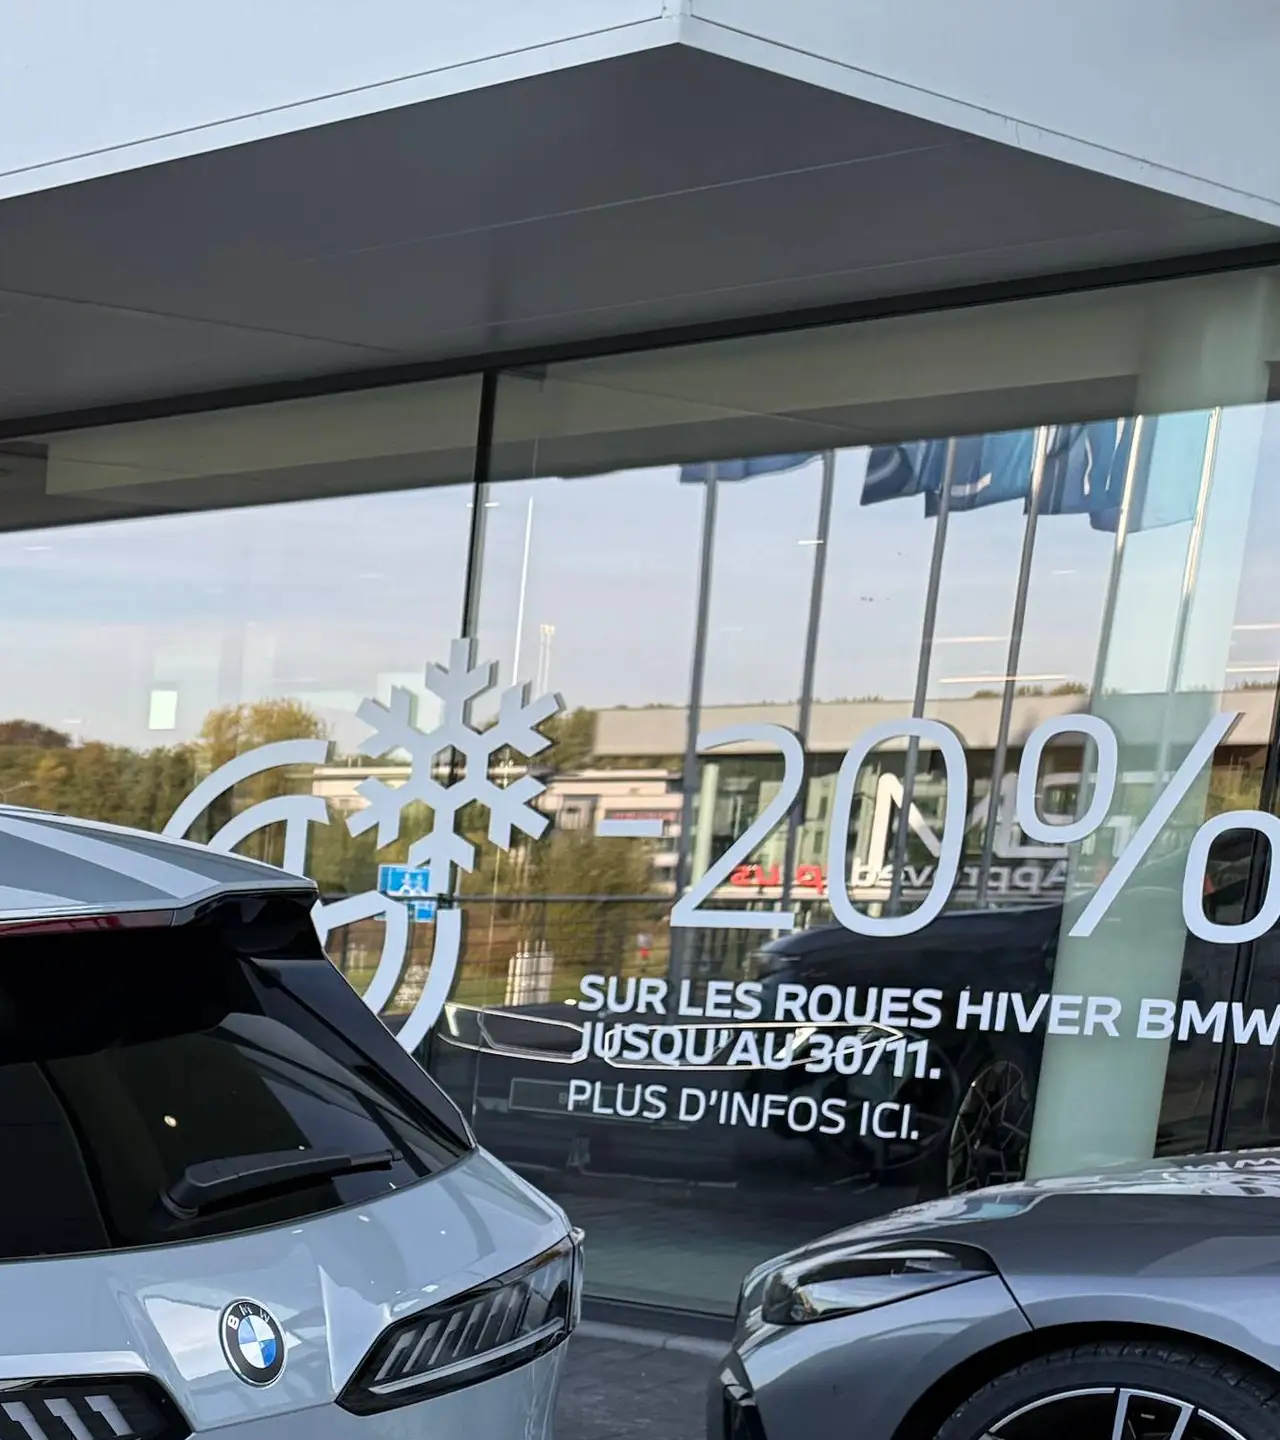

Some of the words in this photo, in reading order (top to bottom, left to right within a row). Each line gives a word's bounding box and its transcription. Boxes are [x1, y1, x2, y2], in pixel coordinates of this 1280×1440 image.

[577, 974, 668, 1015] SUR
[678, 979, 764, 1020] LES
[774, 983, 943, 1029] ROUES
[955, 989, 1122, 1037] HIVER
[1136, 998, 1280, 1046] BMW
[572, 1020, 794, 1071] JUSQU'AU
[804, 1032, 941, 1080] 30/11.
[567, 1079, 668, 1120] PLUS
[678, 1087, 847, 1135] D'INFOS
[859, 1101, 919, 1140] ICI.
[227, 1303, 271, 1331] BMW
